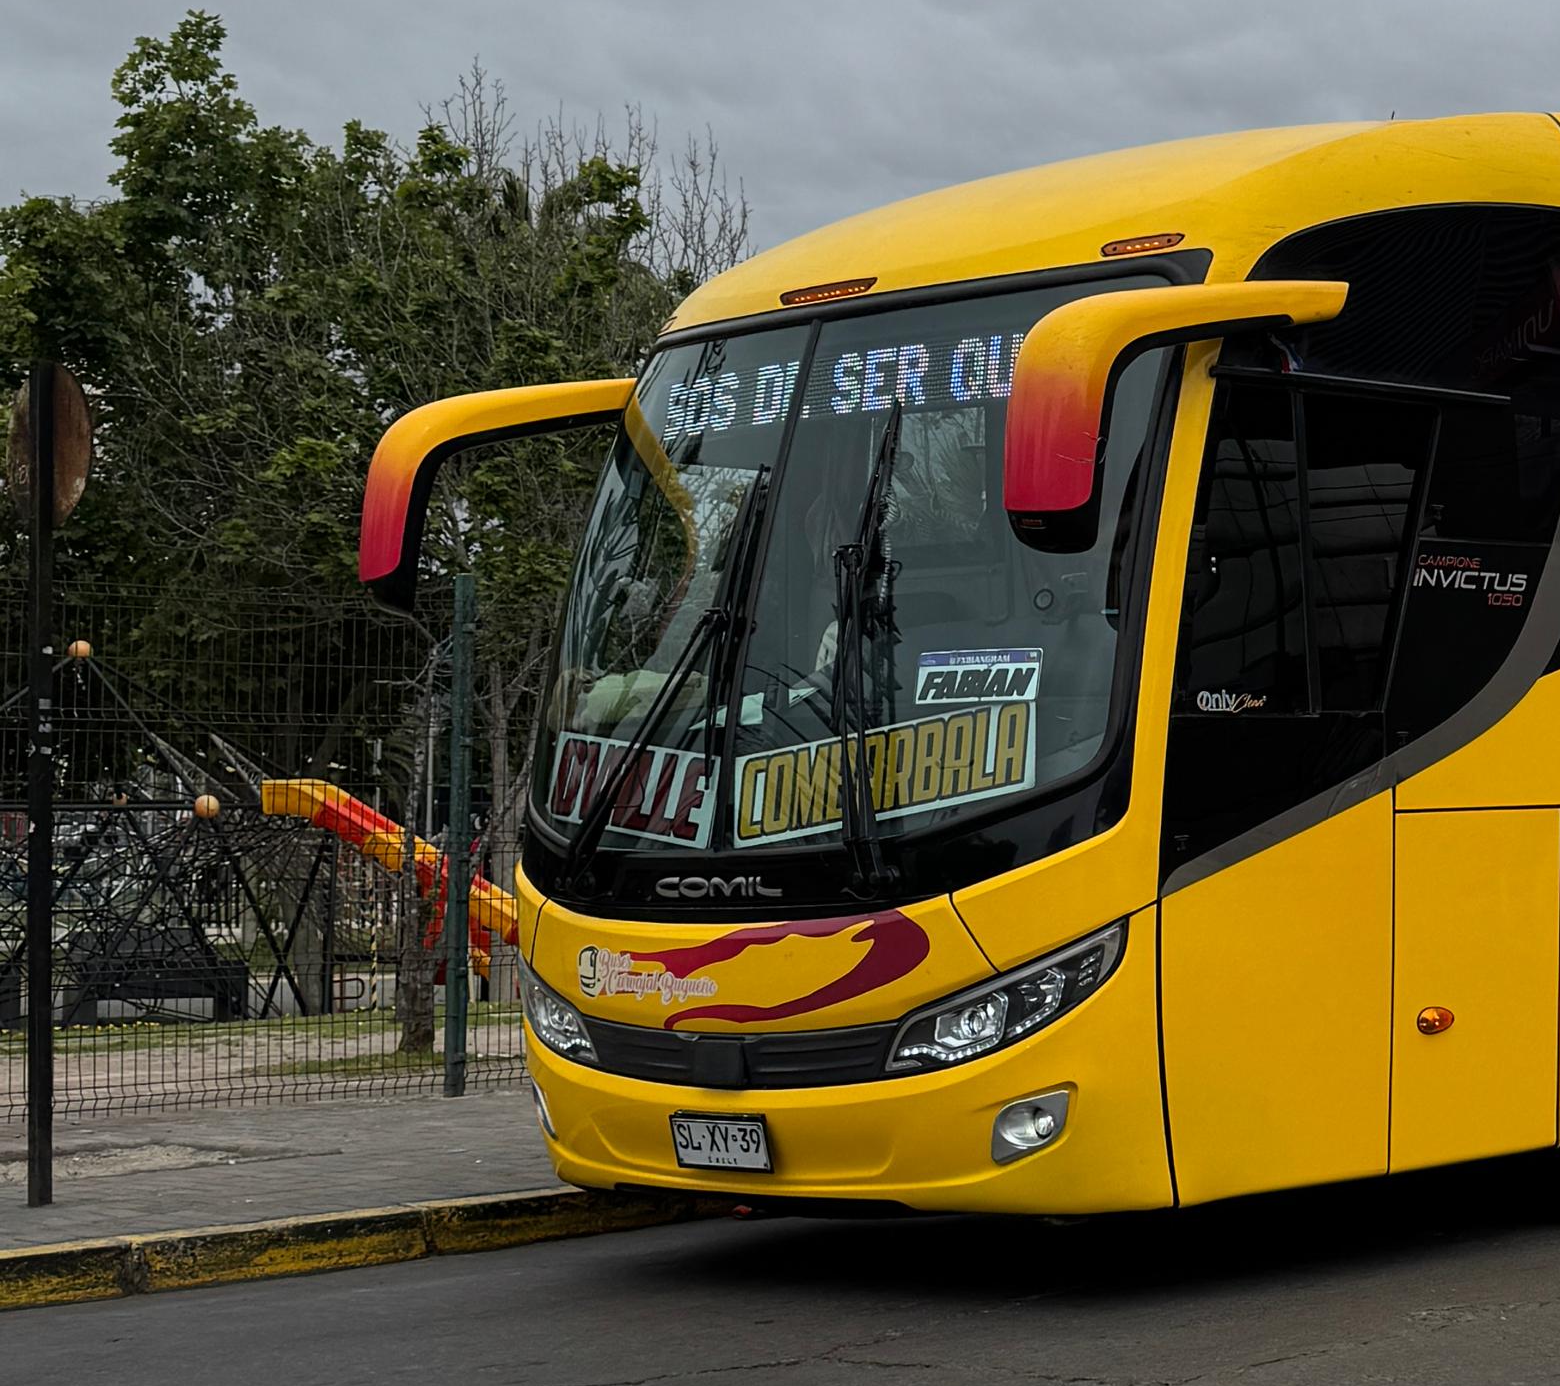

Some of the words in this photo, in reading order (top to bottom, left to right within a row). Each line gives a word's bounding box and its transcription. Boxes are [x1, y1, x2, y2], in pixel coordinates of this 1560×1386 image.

[831, 343, 930, 414] SER
[1418, 554, 1482, 569] CAMPIONE
[1413, 568, 1528, 591] INVICTUS
[1487, 593, 1523, 606] 1050
[655, 875, 783, 898] COMIL
